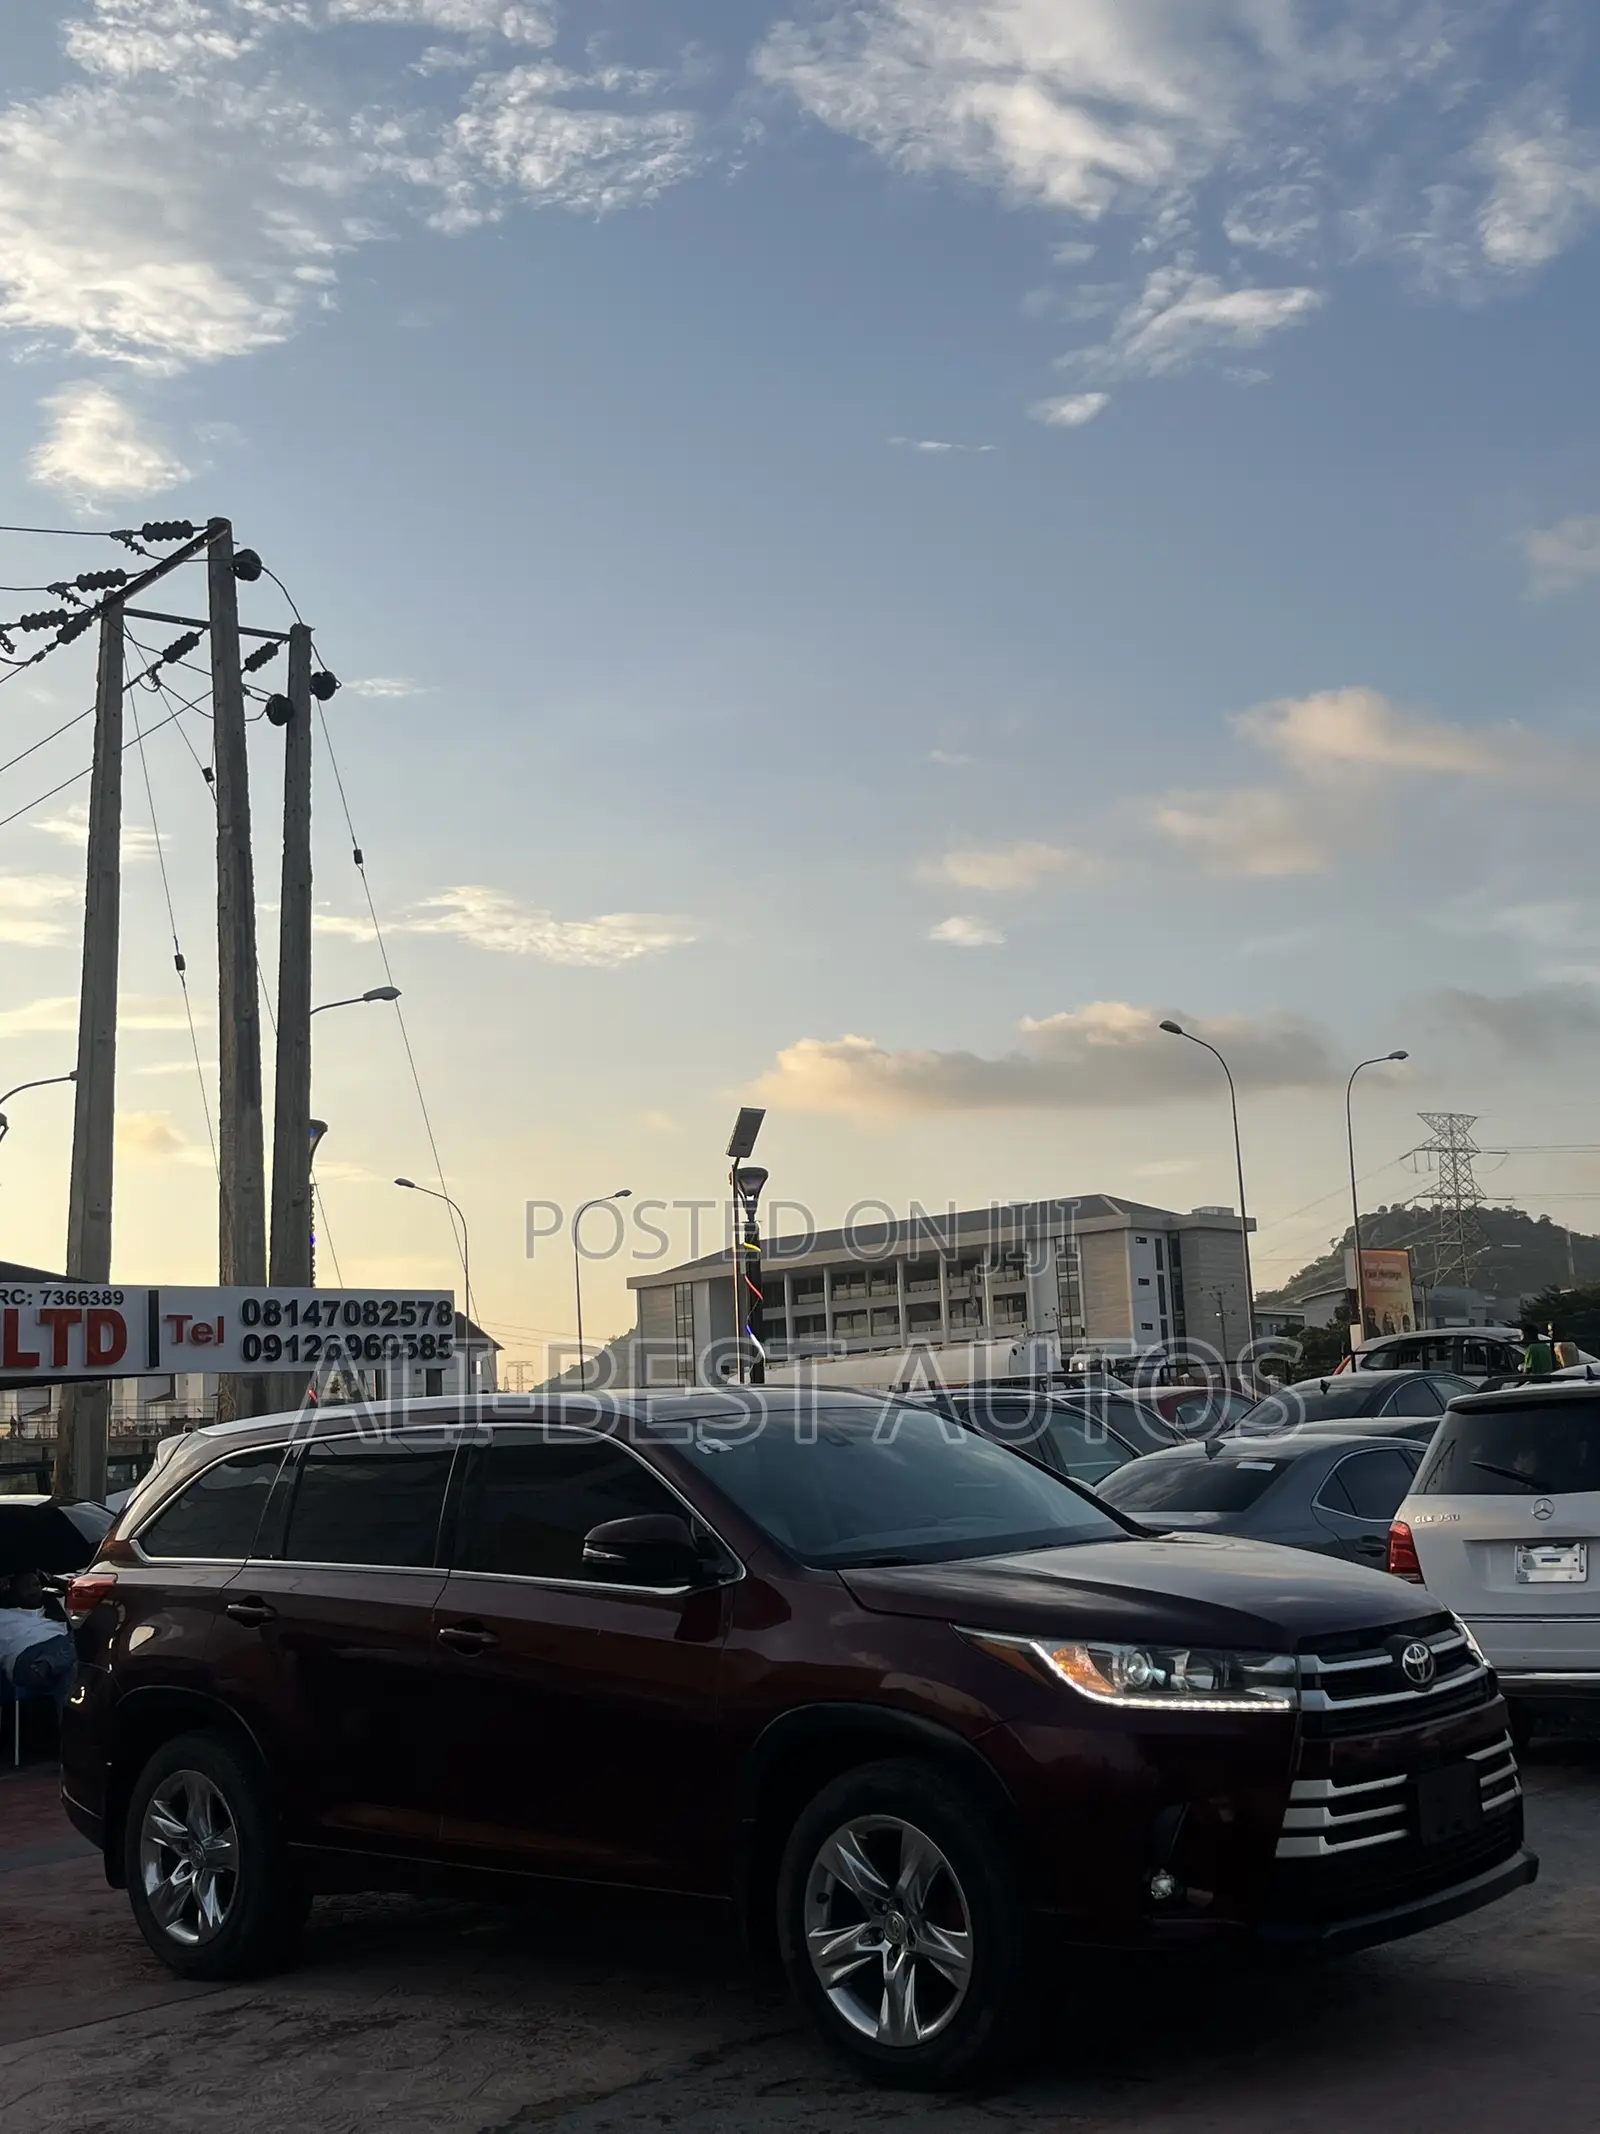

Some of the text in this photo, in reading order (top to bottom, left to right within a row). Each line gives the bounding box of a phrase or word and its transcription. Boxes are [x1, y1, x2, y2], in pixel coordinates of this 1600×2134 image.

[39, 1290, 125, 1306] 7366389
[241, 1298, 454, 1327] 08147082578
[3, 1308, 127, 1367] LTD
[165, 1314, 225, 1345] Tel
[241, 1333, 454, 1362] 09126969585
